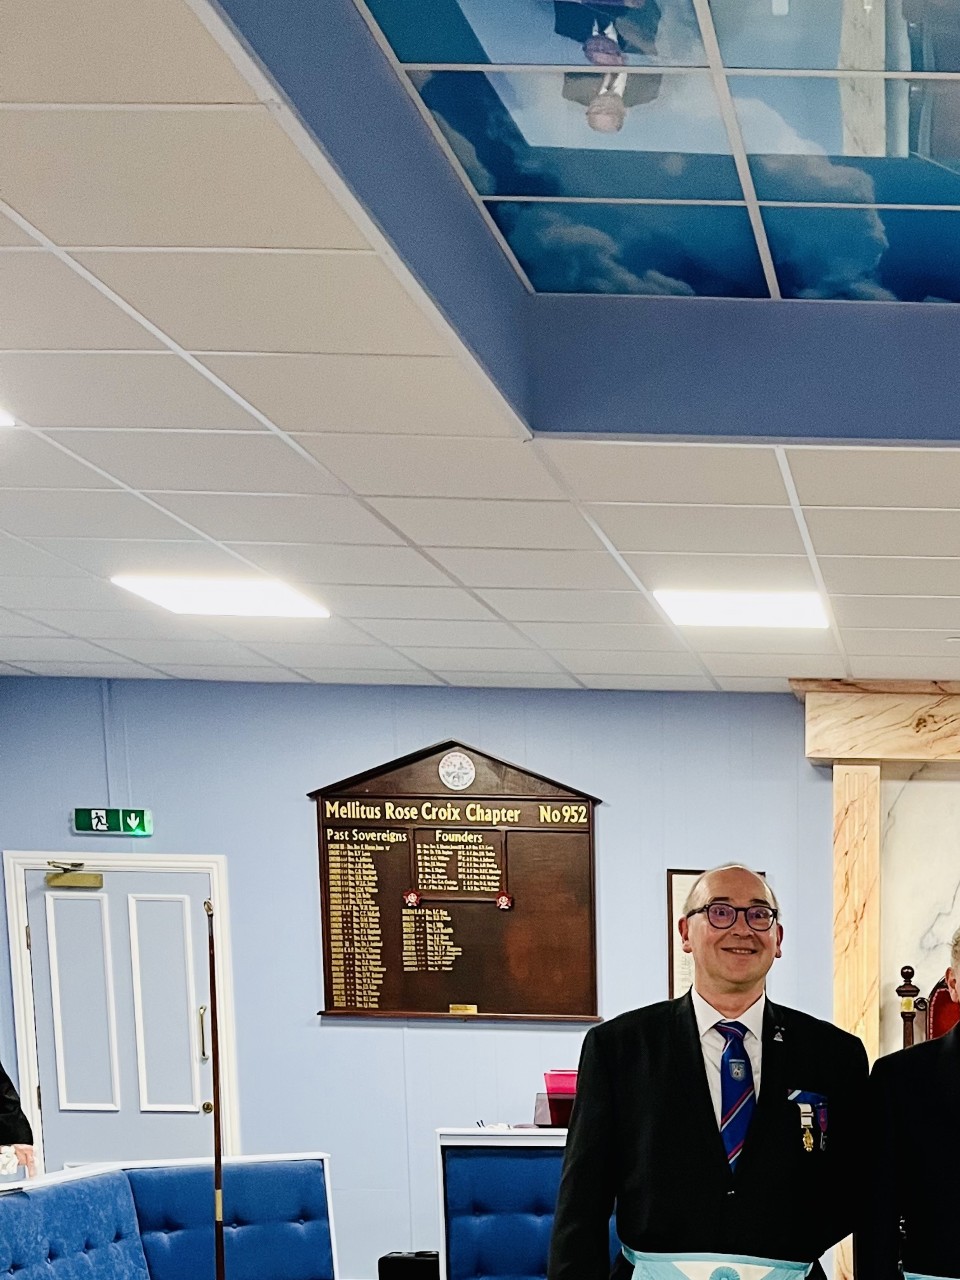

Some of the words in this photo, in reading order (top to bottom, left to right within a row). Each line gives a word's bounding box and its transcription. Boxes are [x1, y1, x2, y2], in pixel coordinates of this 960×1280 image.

[325, 800, 381, 819] Mellitus
[385, 801, 418, 820] Rose
[421, 801, 461, 820] Croix
[465, 803, 521, 825] Chapter
[327, 828, 349, 841] Past
[352, 828, 408, 843] Sovereigns
[435, 829, 483, 843] Founders
